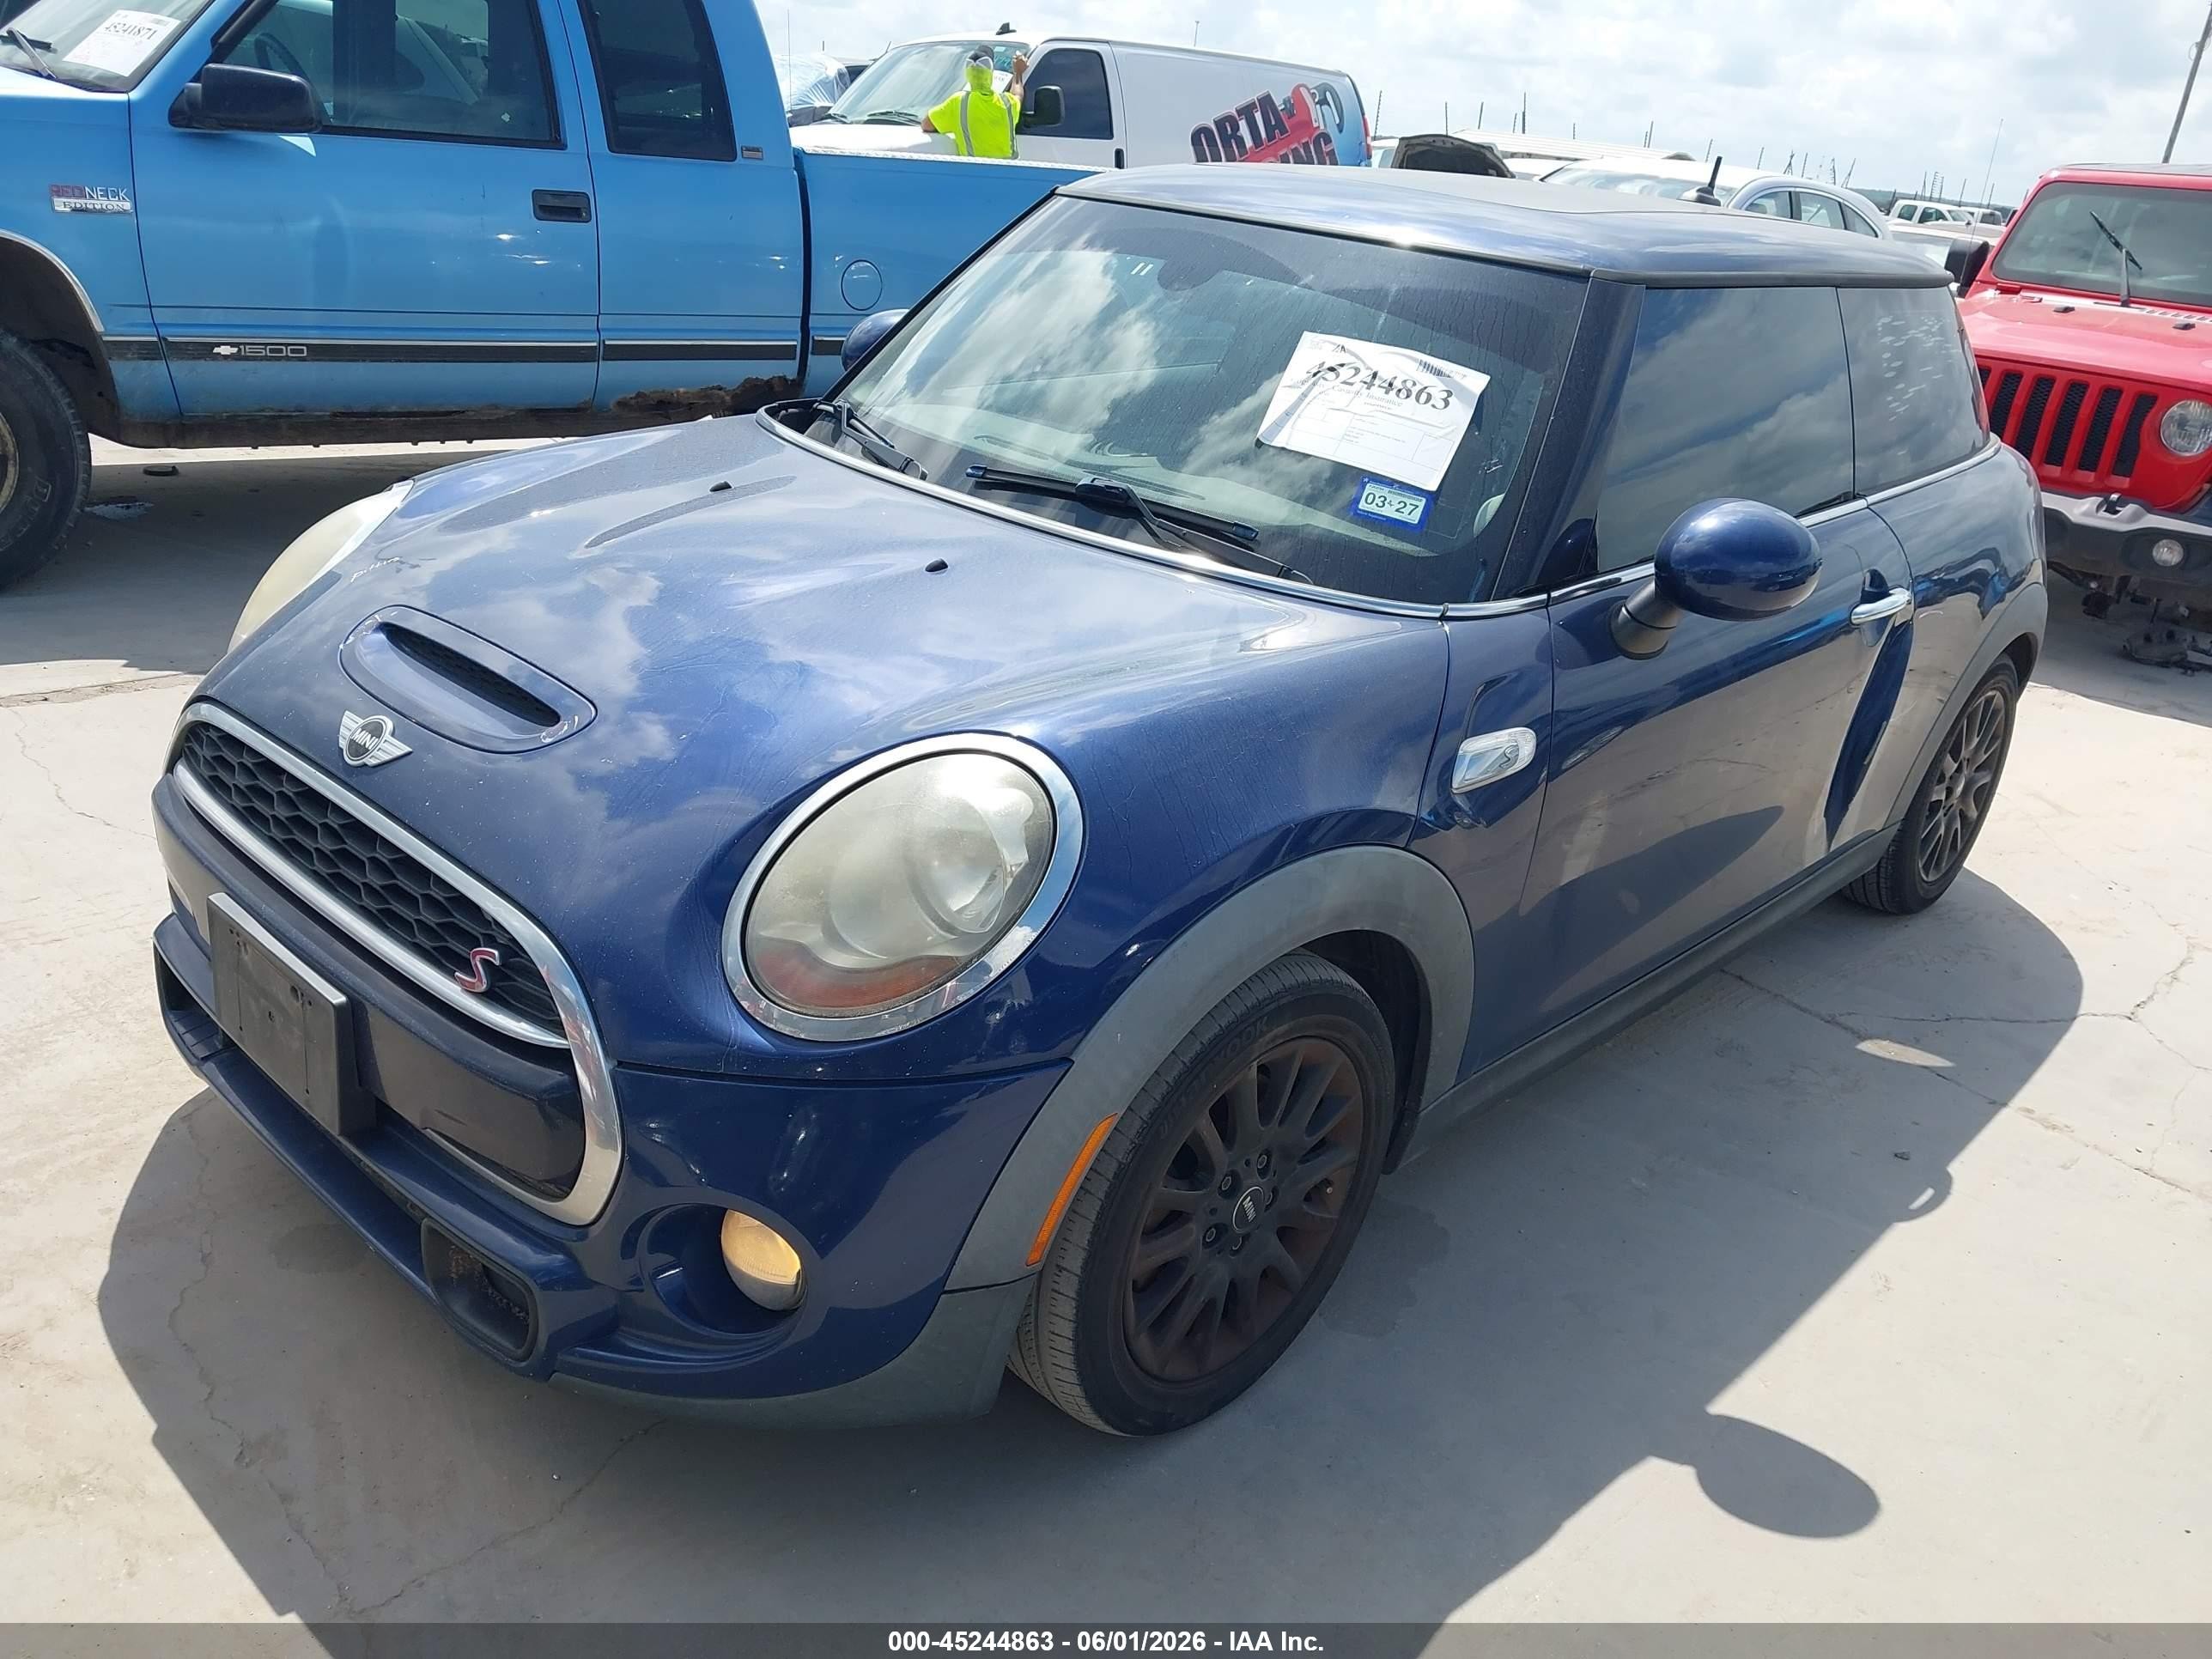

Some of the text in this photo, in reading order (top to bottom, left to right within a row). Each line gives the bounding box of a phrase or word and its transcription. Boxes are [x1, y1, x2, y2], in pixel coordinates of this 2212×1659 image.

[103, 21, 159, 40] 45241871
[50, 185, 130, 202] REDNECK
[63, 201, 125, 212] EDITION
[240, 345, 307, 356] 1500
[1305, 361, 1454, 410] 45244863
[1364, 492, 1388, 508] 03
[1395, 501, 1419, 516] 27
[351, 727, 379, 750] MINI
[454, 948, 499, 992] S
[1243, 1195, 1256, 1222] MINI
